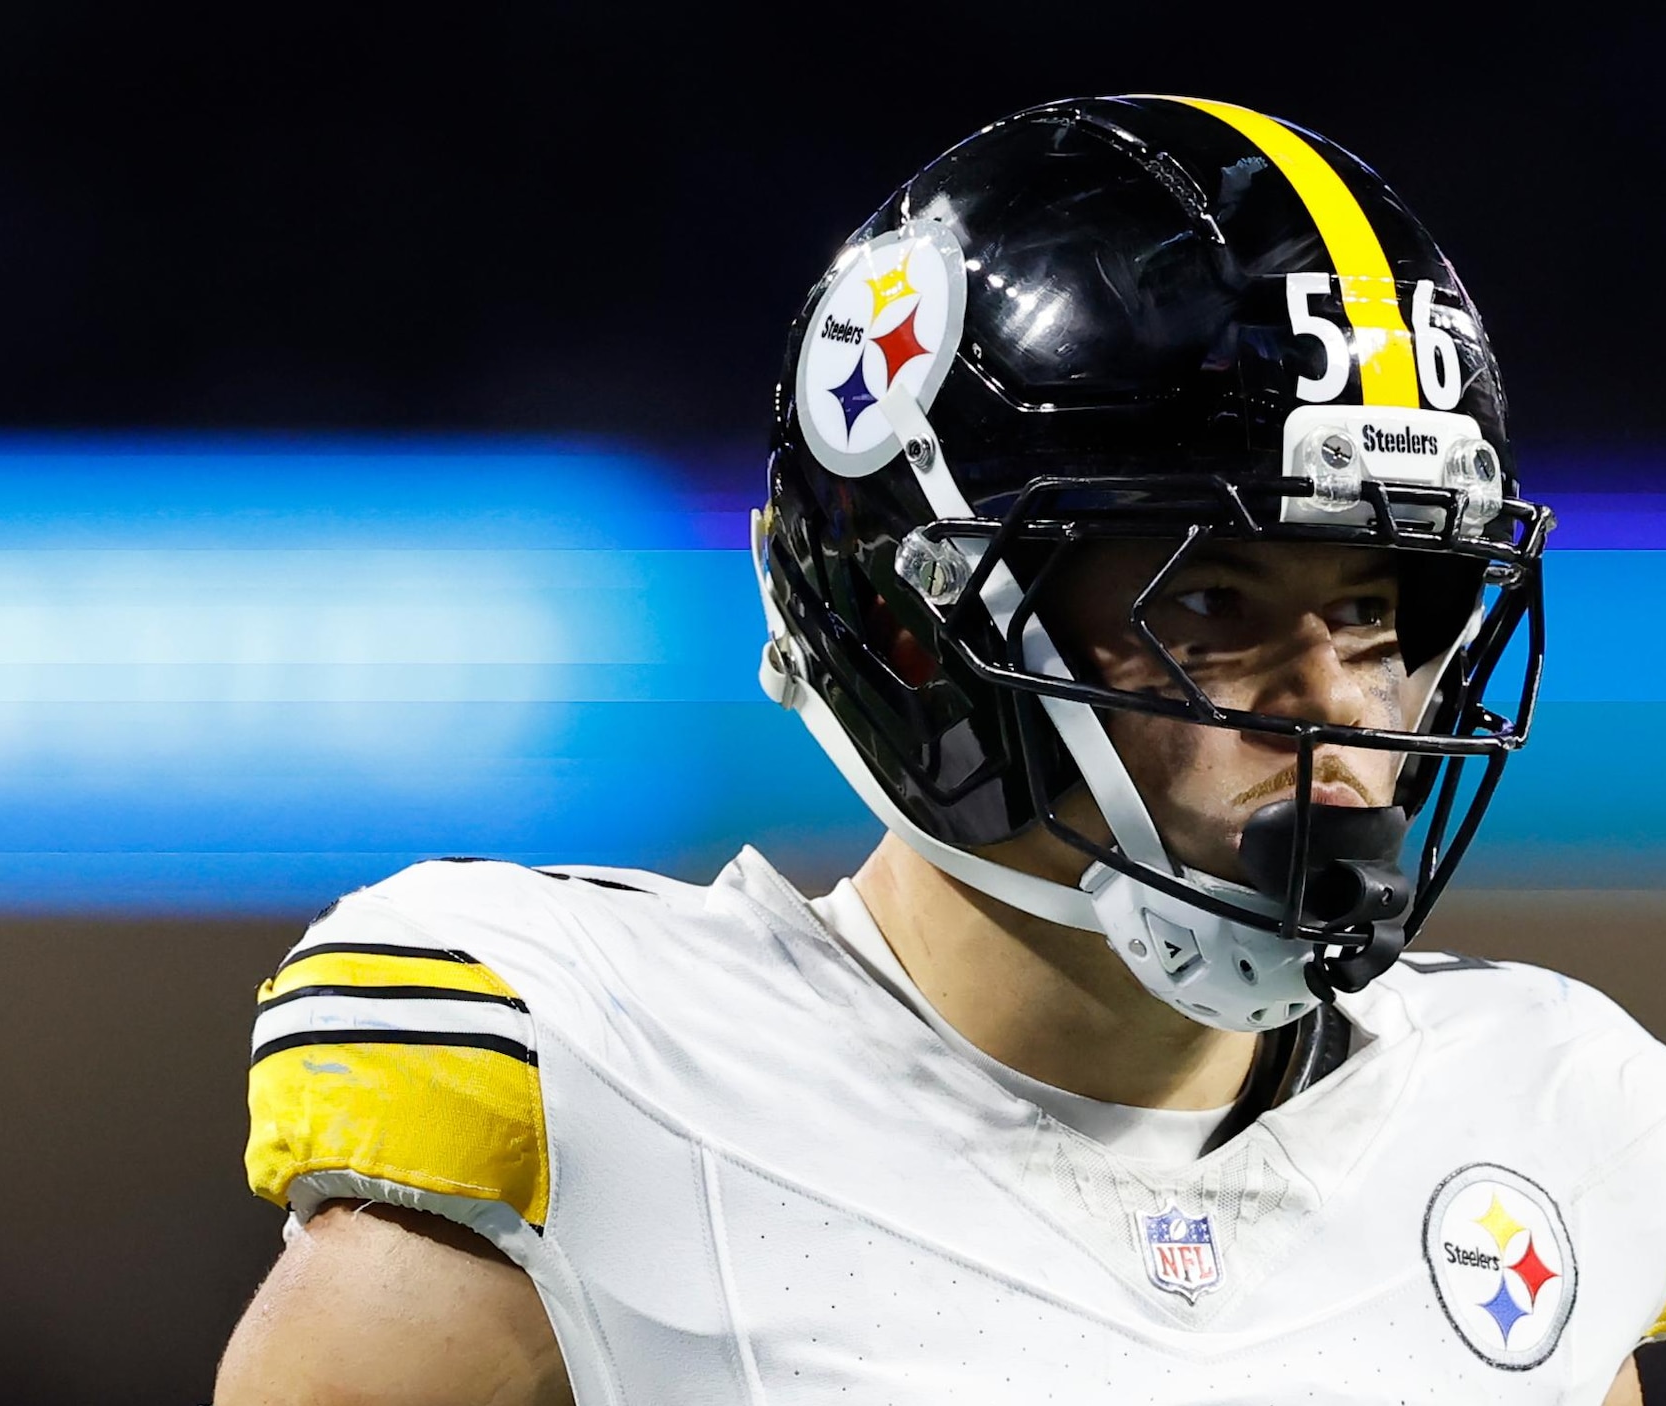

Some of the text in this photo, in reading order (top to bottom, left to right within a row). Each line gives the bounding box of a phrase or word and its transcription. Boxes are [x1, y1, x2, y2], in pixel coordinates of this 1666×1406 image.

[821, 314, 864, 345] Steelers
[1362, 424, 1438, 455] Steelers
[1156, 1246, 1214, 1282] NFL
[1444, 1242, 1500, 1271] Steelers
